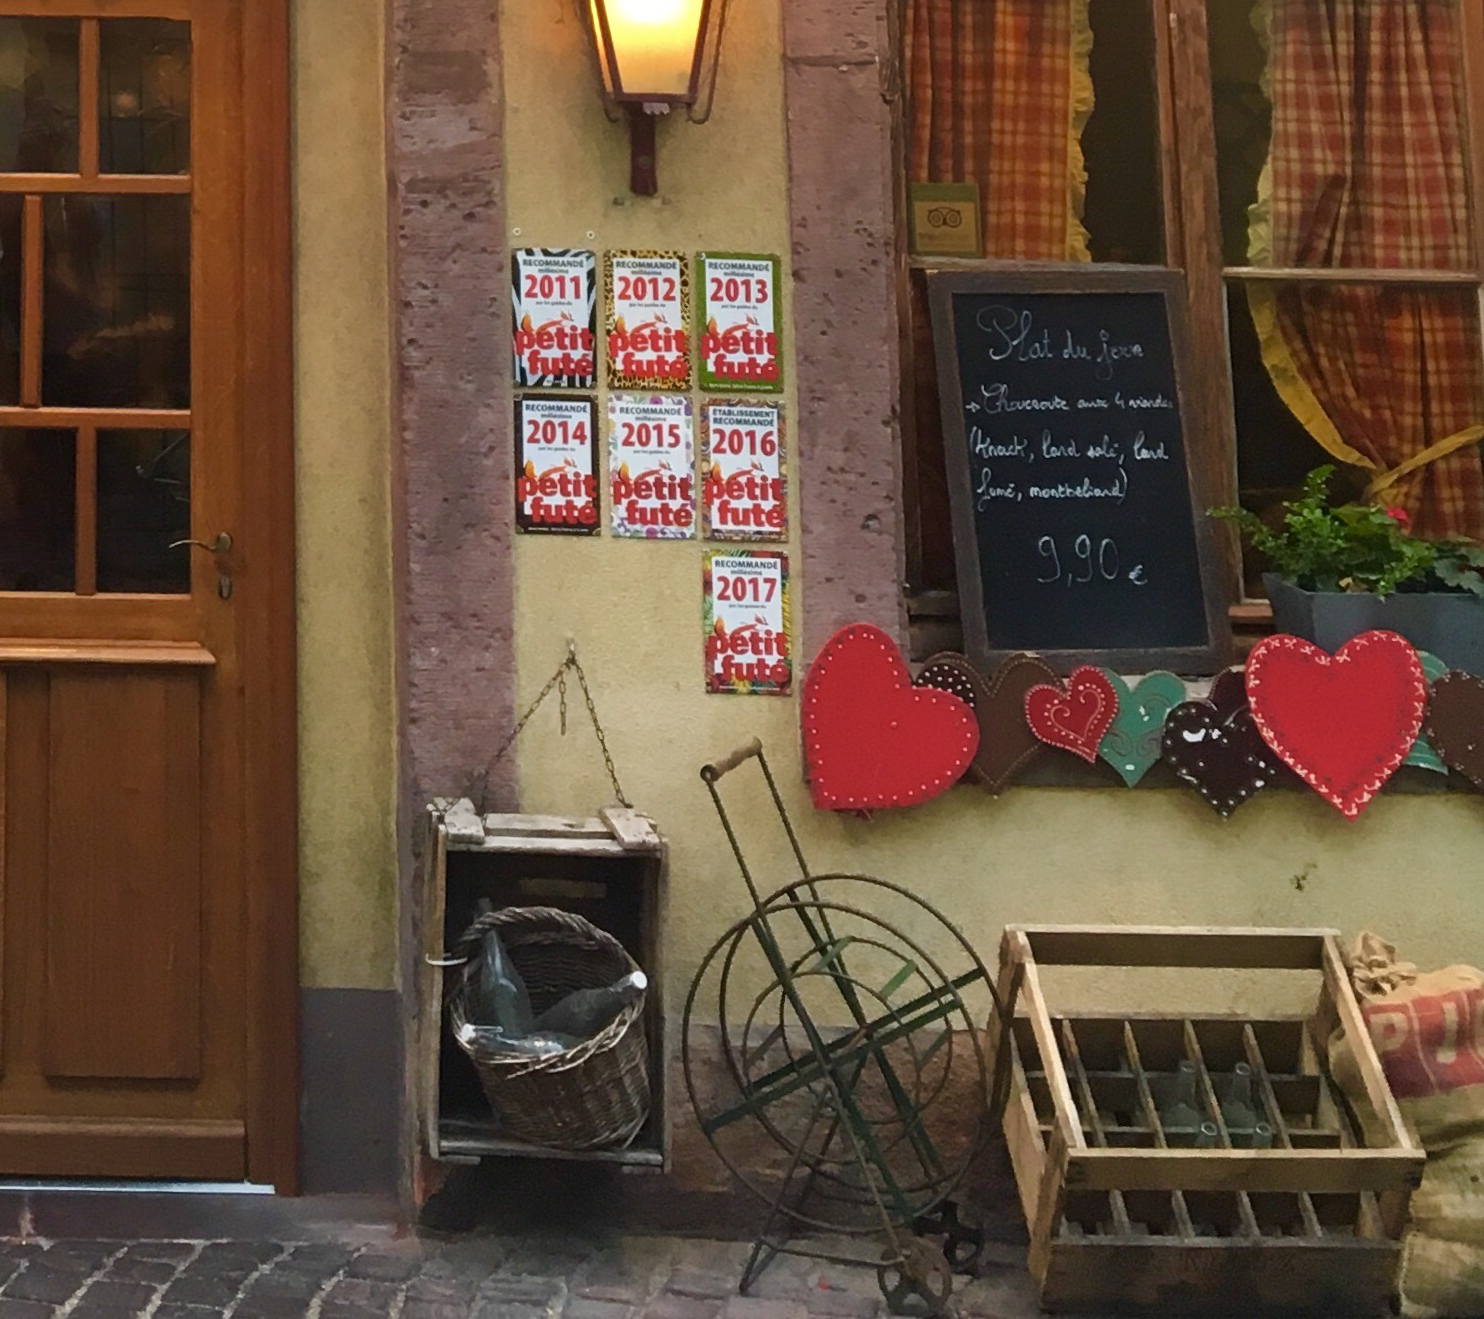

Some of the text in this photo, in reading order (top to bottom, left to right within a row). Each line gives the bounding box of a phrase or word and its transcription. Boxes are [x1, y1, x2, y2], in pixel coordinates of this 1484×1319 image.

[522, 258, 584, 268] RECOMMANDÉ
[616, 260, 677, 270] RECOMMANDÉ
[708, 262, 770, 272] RECOMMANDÉ
[524, 274, 581, 299] 2011
[617, 276, 676, 301] 2012
[710, 277, 769, 303] 2013
[515, 325, 594, 355] petit
[609, 326, 688, 358] petit
[700, 329, 779, 360] petit
[976, 304, 1053, 361] Plat
[1063, 329, 1091, 360] du
[528, 349, 593, 376] futé
[621, 352, 688, 379] futé
[714, 353, 779, 382] futé
[525, 403, 588, 413] RECOMMANDÉ
[619, 406, 682, 416] RECOMMANDÉ
[526, 419, 587, 445] 2014
[621, 422, 681, 448] 2015
[712, 417, 775, 427] RECOMMANDÉ
[712, 428, 776, 457] 2016
[517, 471, 597, 502] petit
[613, 474, 693, 505] petit
[704, 475, 786, 506] petit
[530, 497, 597, 524] futé
[626, 499, 693, 528] futé
[718, 499, 786, 528] futé
[714, 560, 778, 569] RECOMMANDÉ
[1037, 534, 1118, 587] 9,90
[716, 576, 777, 602] 2017
[707, 629, 789, 661] petit
[721, 654, 789, 682] futé
